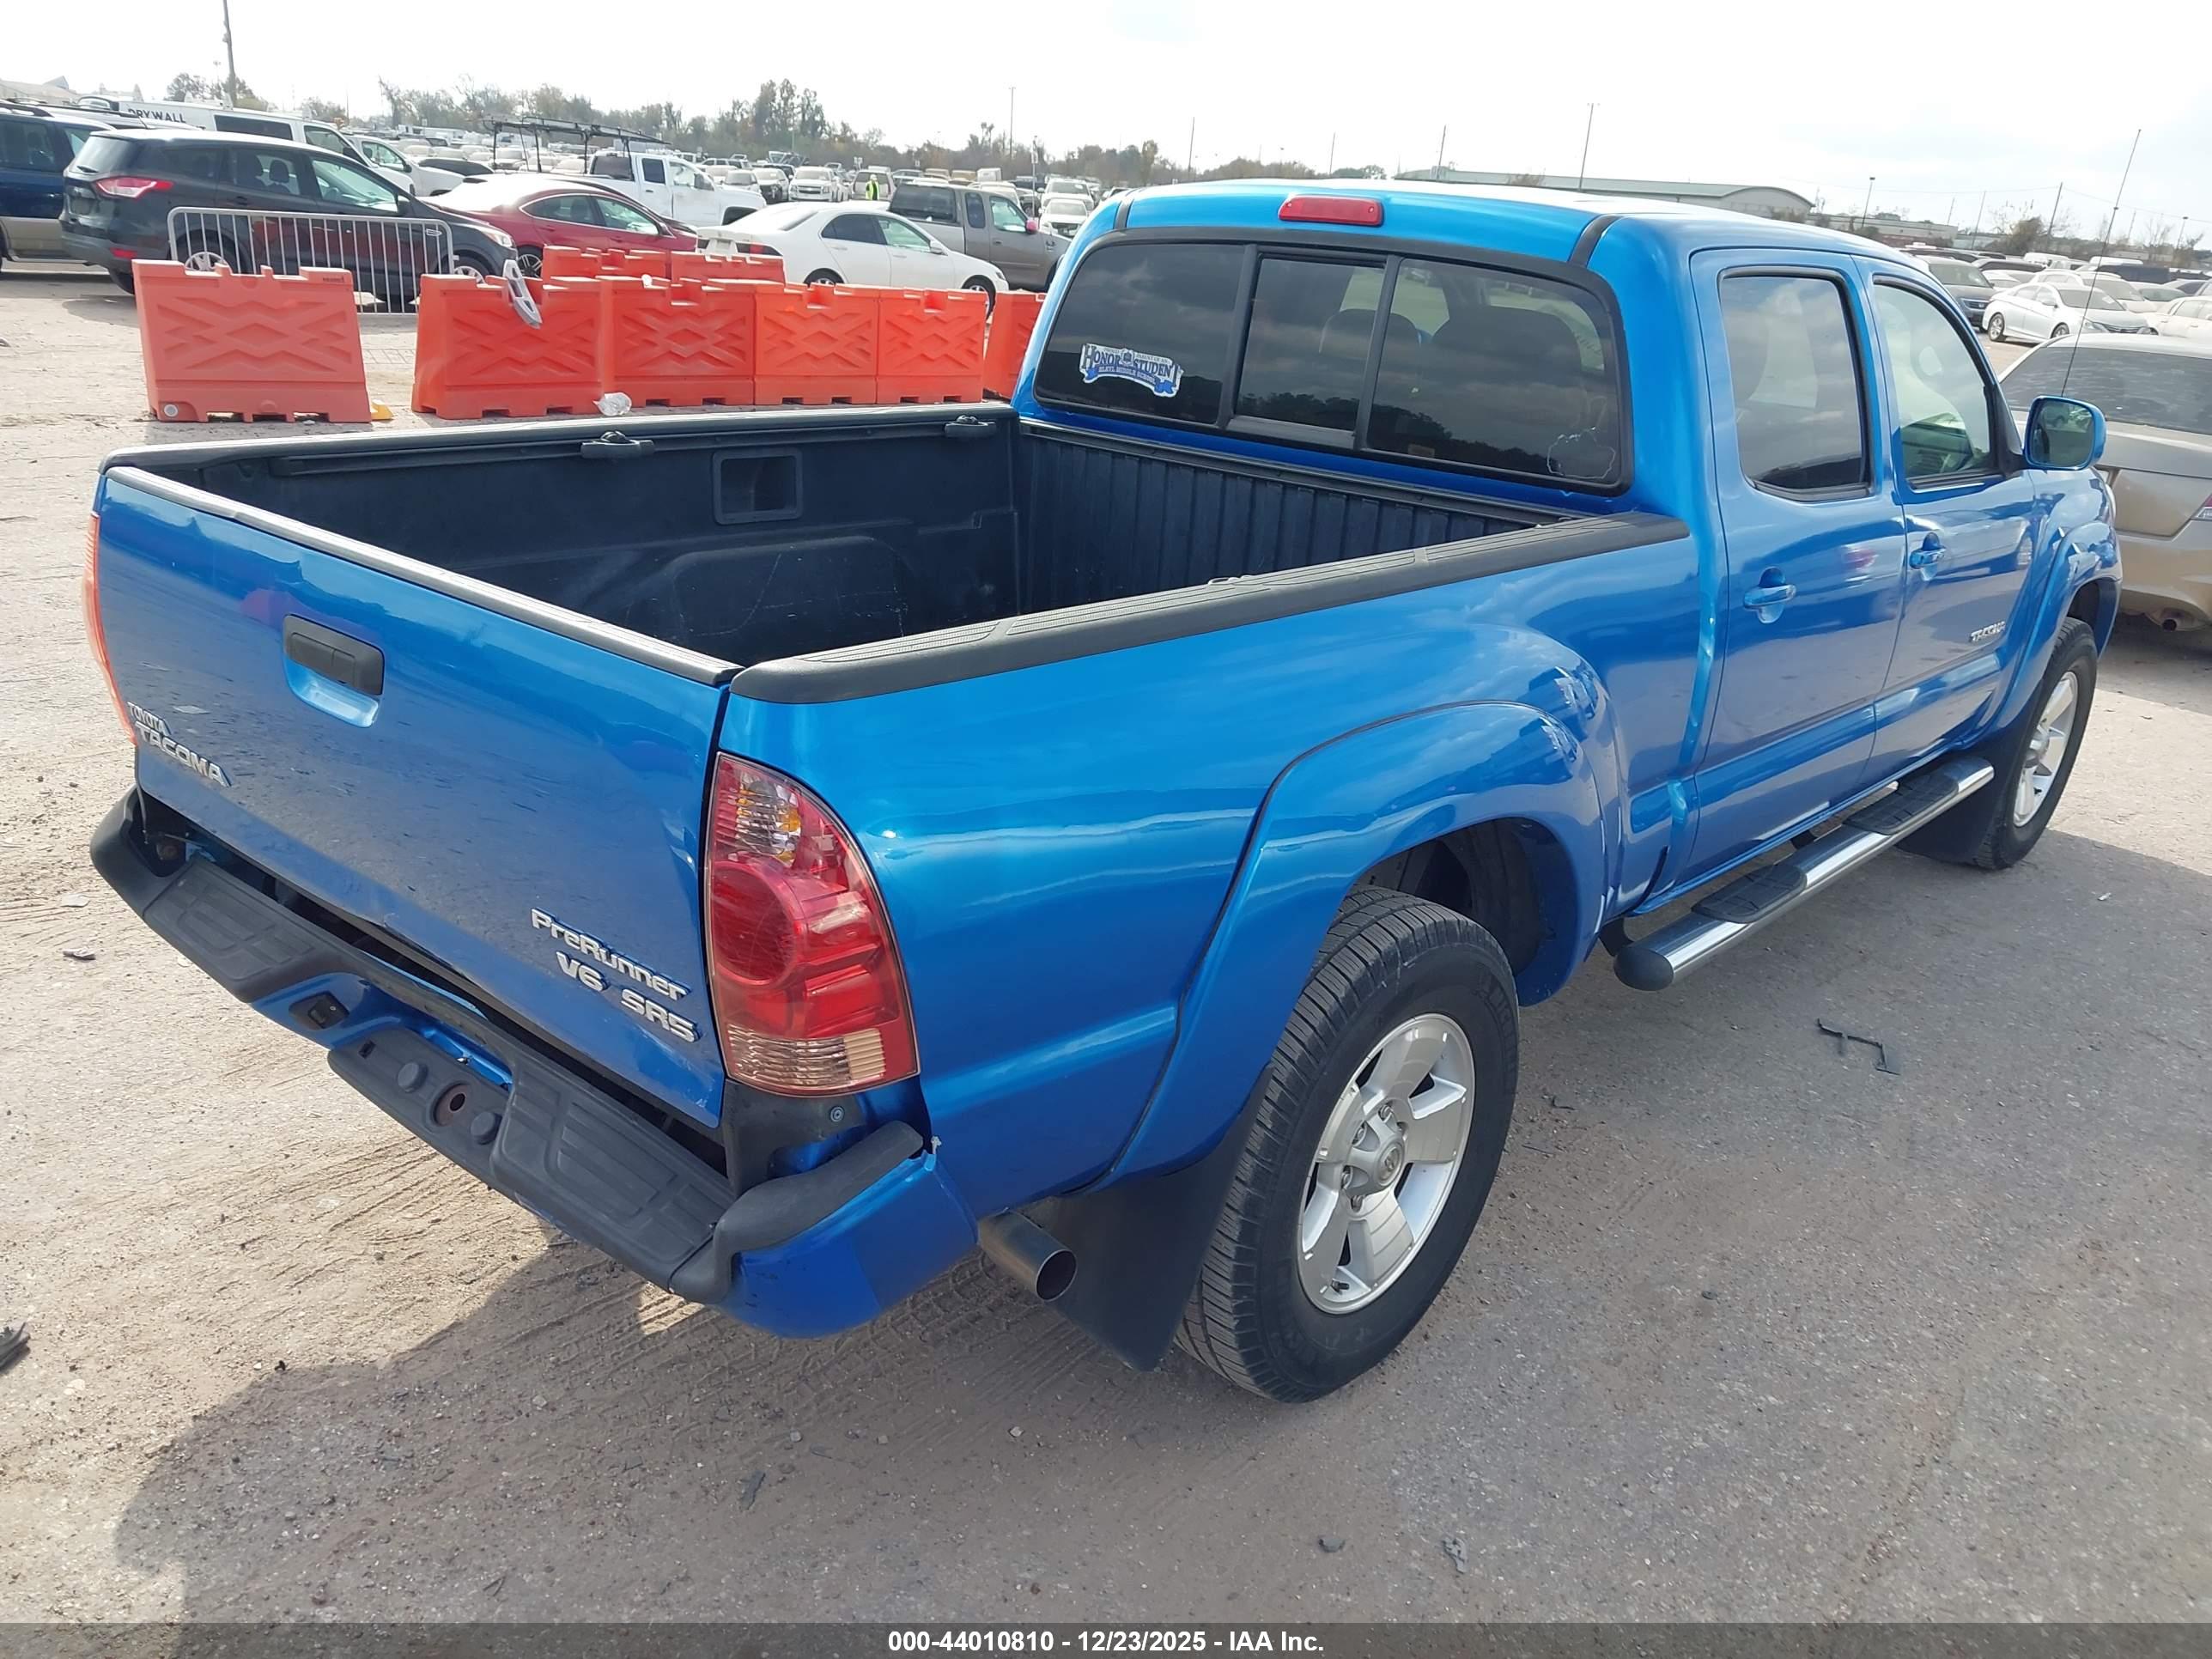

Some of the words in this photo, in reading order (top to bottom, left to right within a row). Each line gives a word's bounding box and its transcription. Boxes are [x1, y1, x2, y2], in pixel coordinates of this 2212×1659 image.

[1083, 344, 1121, 370] HONOR
[1133, 358, 1182, 389] STUDENT
[127, 702, 172, 736] TOYOTA
[135, 720, 232, 787] TACOMA
[532, 907, 692, 1000] PreRunner
[556, 951, 610, 992] V6
[620, 988, 702, 1042] SR5
